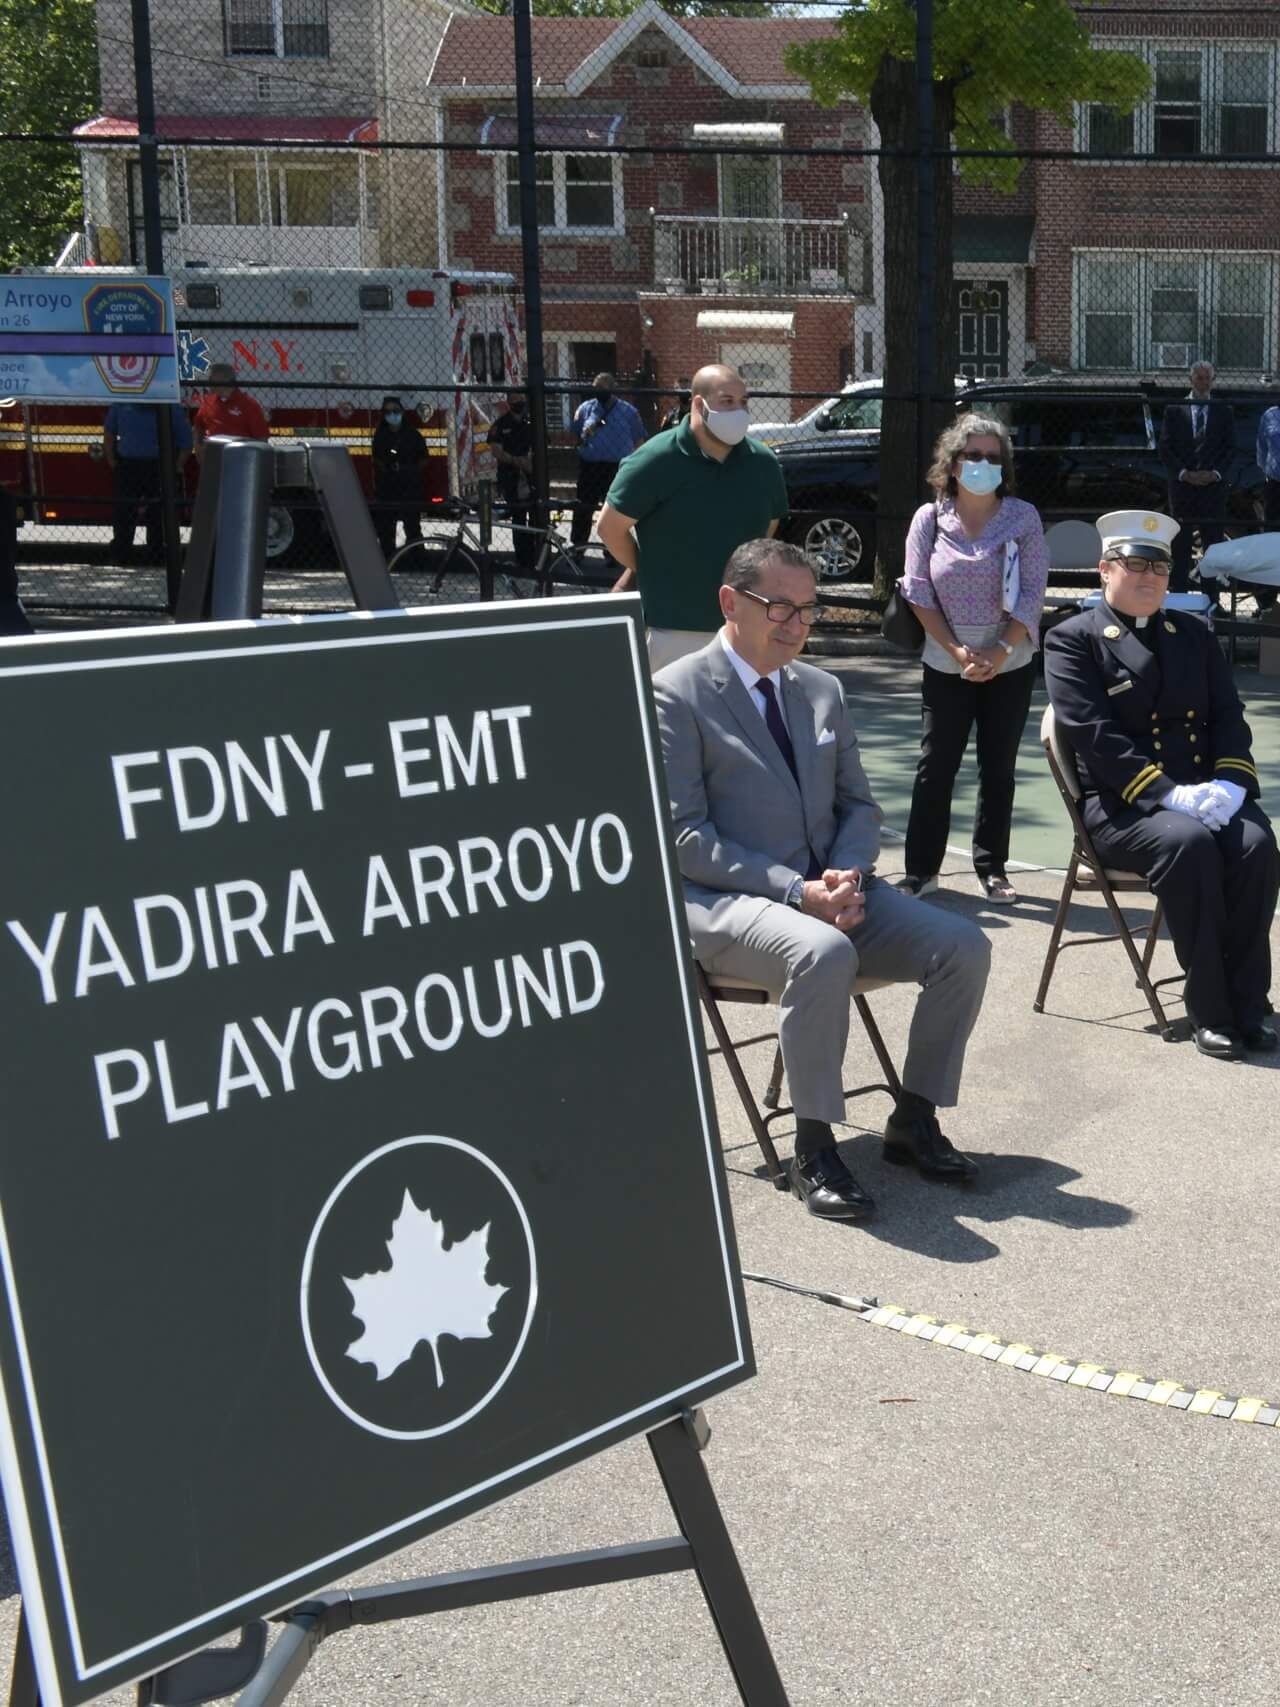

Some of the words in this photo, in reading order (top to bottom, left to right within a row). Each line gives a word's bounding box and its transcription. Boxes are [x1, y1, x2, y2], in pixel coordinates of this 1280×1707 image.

[4, 289, 73, 312] Arroyo
[110, 303, 126, 312] CITY
[128, 303, 138, 312] OF
[14, 314, 31, 327] 26
[105, 313, 123, 321] NEW
[124, 313, 145, 321] YORK
[231, 340, 304, 373] N.Y.
[7, 870, 334, 1003] YADIRA
[363, 813, 632, 936] ARROYO
[95, 941, 604, 1139] PLAYGROUND
